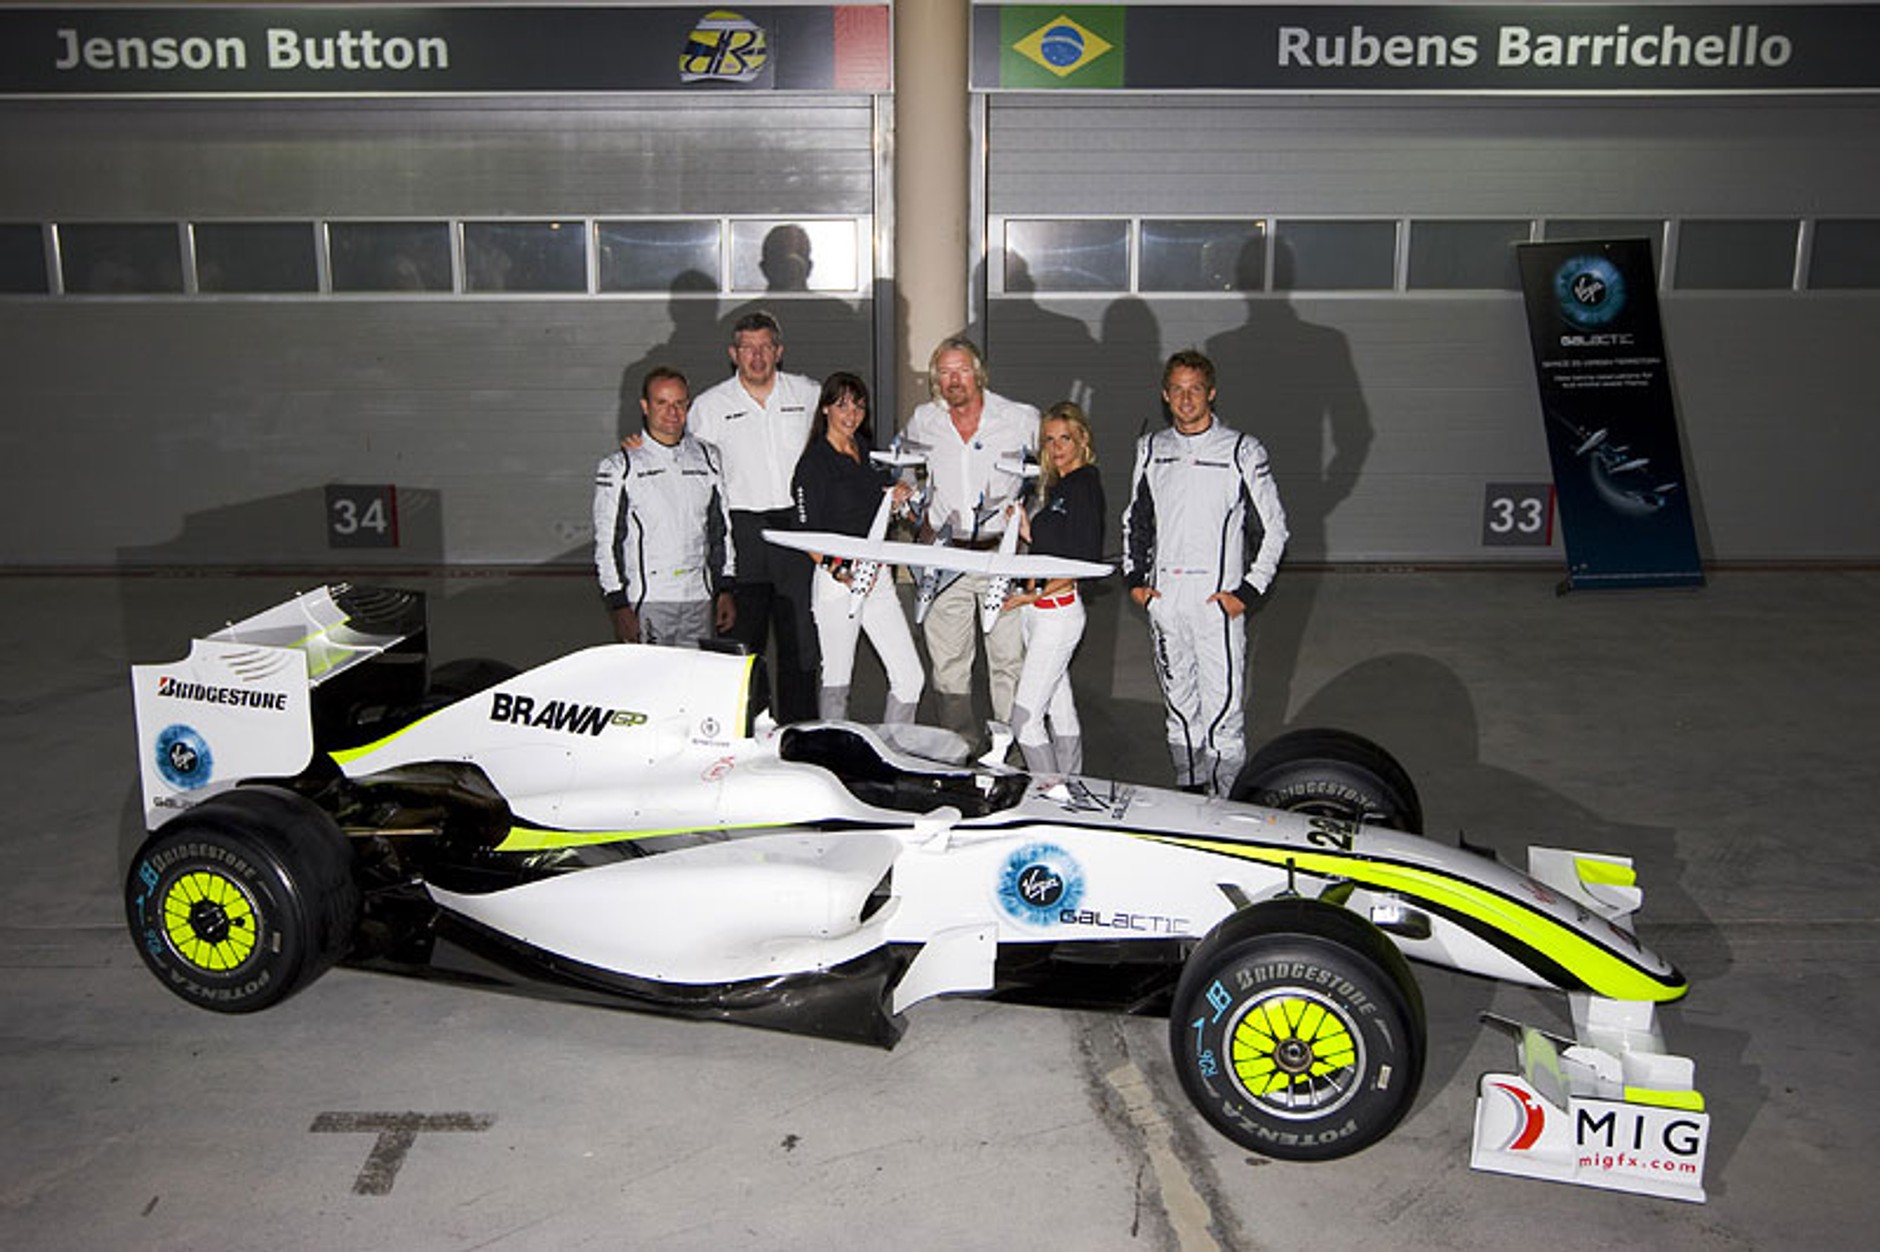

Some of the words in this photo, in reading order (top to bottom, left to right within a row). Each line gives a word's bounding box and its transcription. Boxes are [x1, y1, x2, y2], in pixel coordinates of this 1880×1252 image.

[55, 28, 246, 70] Jenson
[266, 28, 449, 70] Button
[1277, 25, 1478, 67] Rubens
[1497, 25, 1793, 68] Barrichello
[333, 498, 387, 534] 34
[1489, 497, 1543, 533] 33
[157, 677, 288, 711] BRIDGESTONE
[489, 692, 614, 737] BRAWN
[151, 843, 257, 879] BRIDGESTONE
[1021, 868, 1060, 902] Virgin
[169, 968, 271, 1000] POTENZA
[1235, 962, 1377, 1016] BRIDGESTONE
[1221, 1099, 1359, 1147] POTENZA
[1576, 1108, 1702, 1156] MIG
[1578, 1152, 1698, 1174] migfx.com
